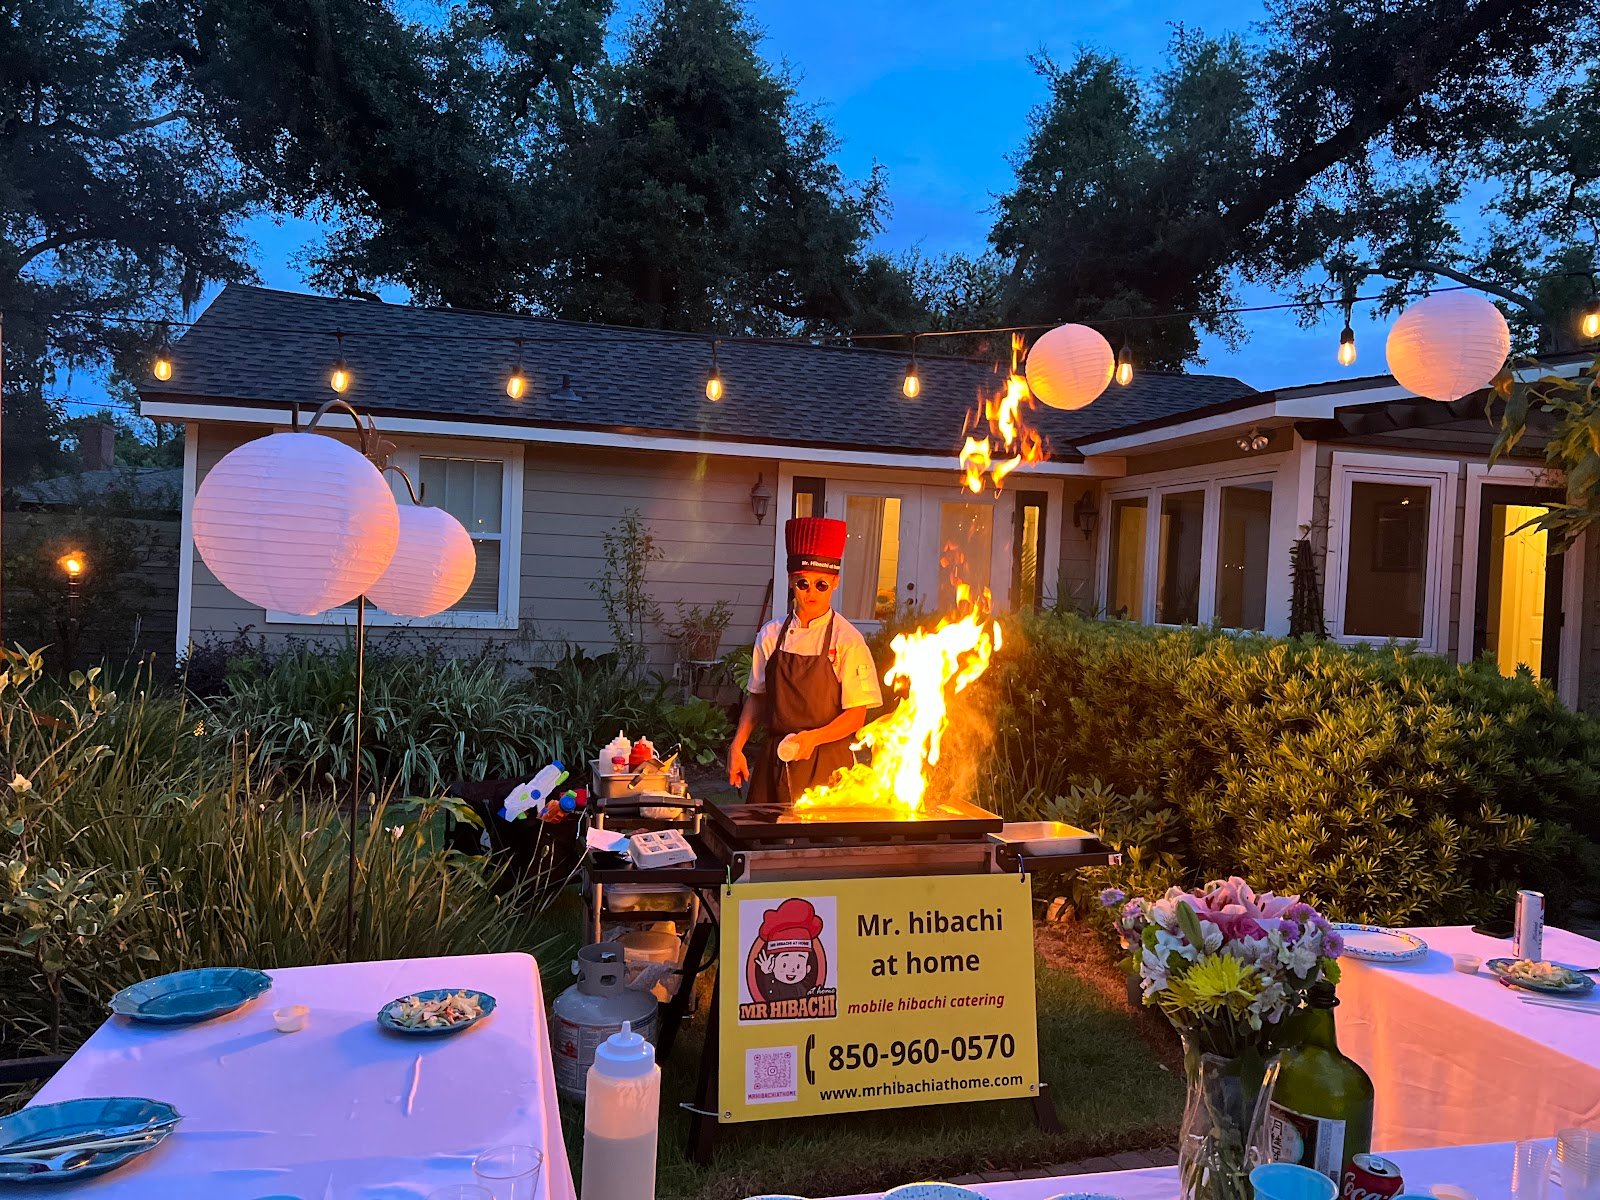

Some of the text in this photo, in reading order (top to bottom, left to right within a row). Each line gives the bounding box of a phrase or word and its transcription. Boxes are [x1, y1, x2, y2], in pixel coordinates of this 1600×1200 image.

[857, 908, 1003, 937] Mr. hibachi
[871, 951, 980, 977] at home
[740, 994, 836, 1019] MR HIBACHI
[847, 993, 1005, 1014] mobile hibachi catering
[828, 1033, 1015, 1071] 850-960-0570
[820, 1074, 1023, 1101] www.mrhibachiathome.com
